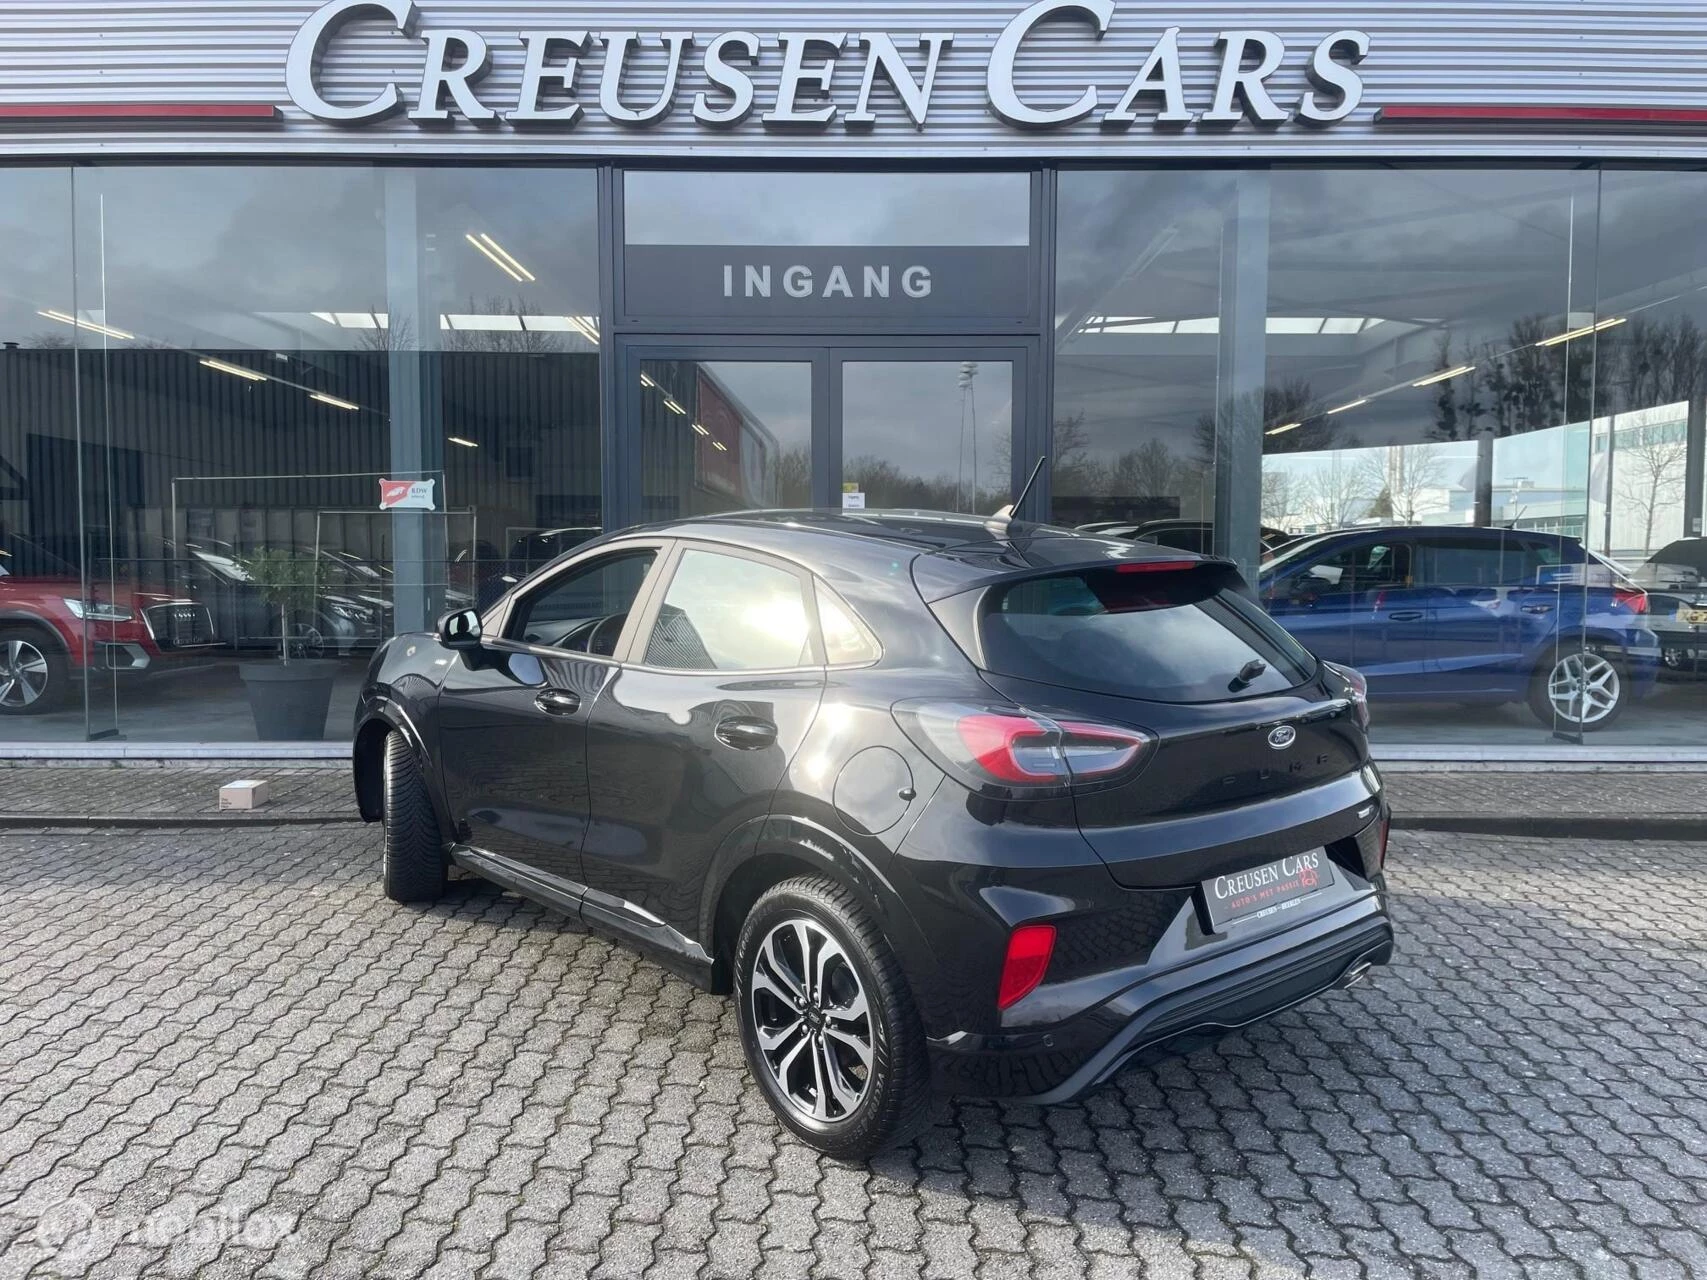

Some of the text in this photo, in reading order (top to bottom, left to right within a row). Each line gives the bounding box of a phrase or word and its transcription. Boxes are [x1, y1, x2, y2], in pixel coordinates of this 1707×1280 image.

[285, 0, 1372, 128] CREUSEN CARS
[723, 264, 932, 298] INGANG
[1214, 852, 1320, 899] CREUSEN CARS
